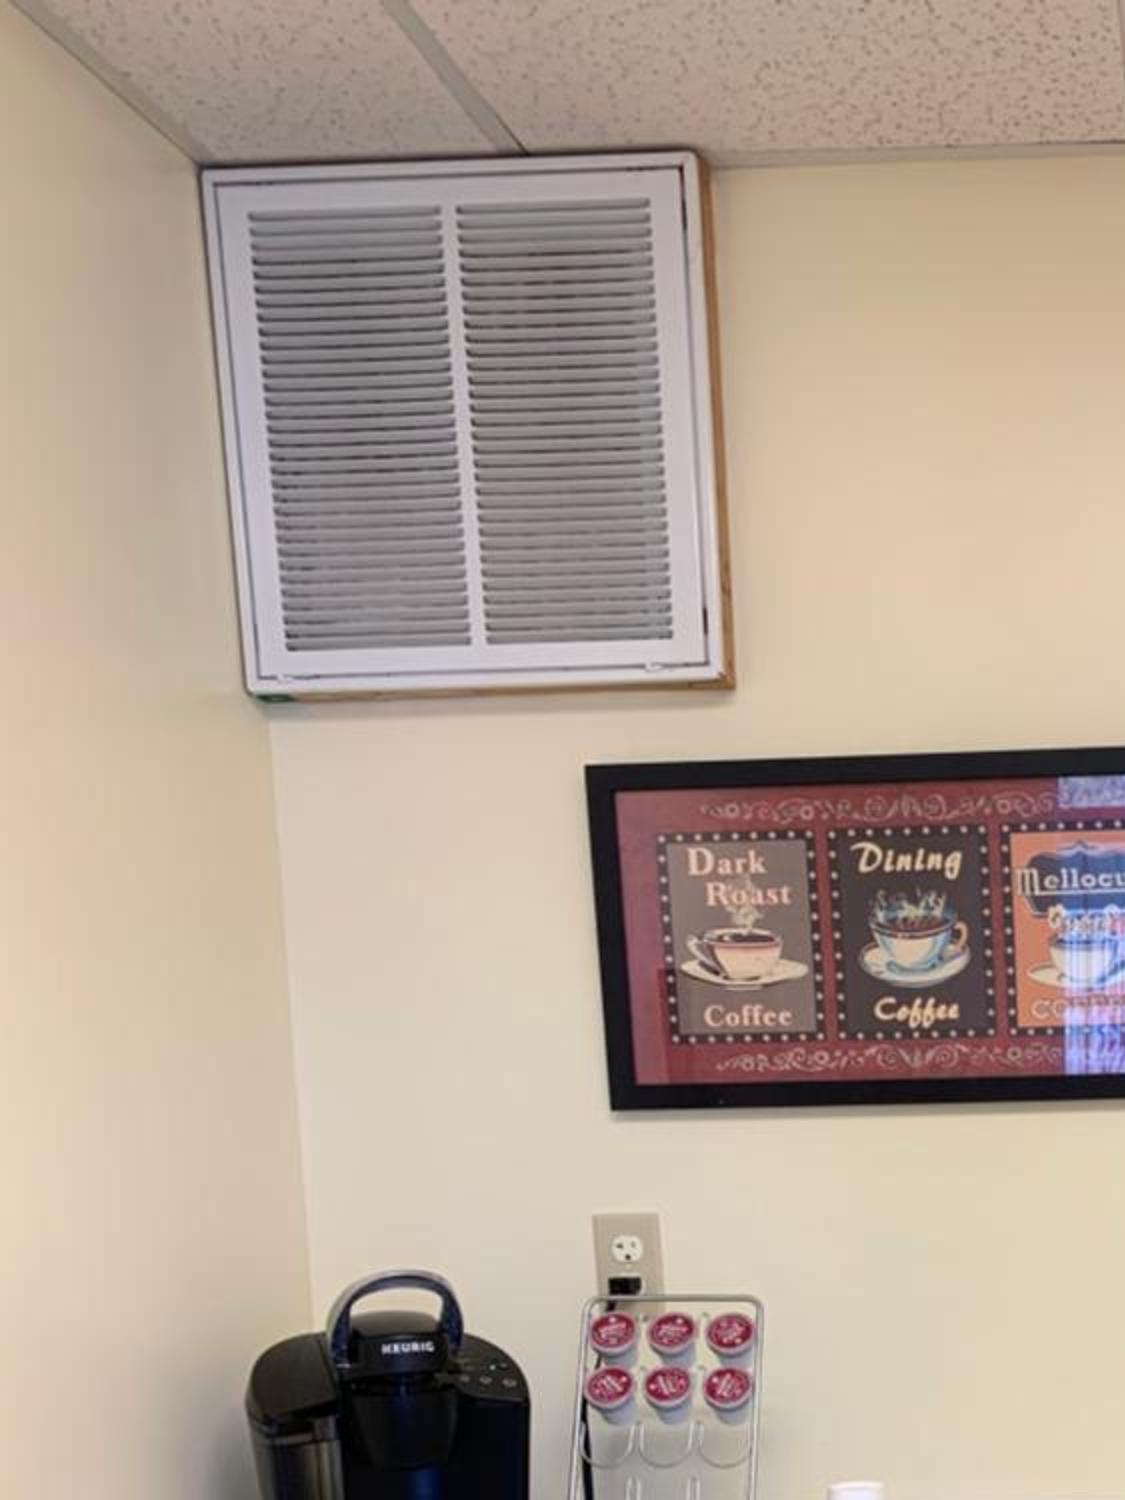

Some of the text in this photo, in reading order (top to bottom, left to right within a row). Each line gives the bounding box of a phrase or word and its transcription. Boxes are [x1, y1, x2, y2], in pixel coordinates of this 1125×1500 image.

[686, 847, 768, 876] Dark
[850, 841, 962, 880] Dining
[705, 881, 792, 907] Roast
[703, 1004, 793, 1027] Coffee
[873, 997, 960, 1029] Coffee
[381, 1340, 435, 1355] KEURIG
